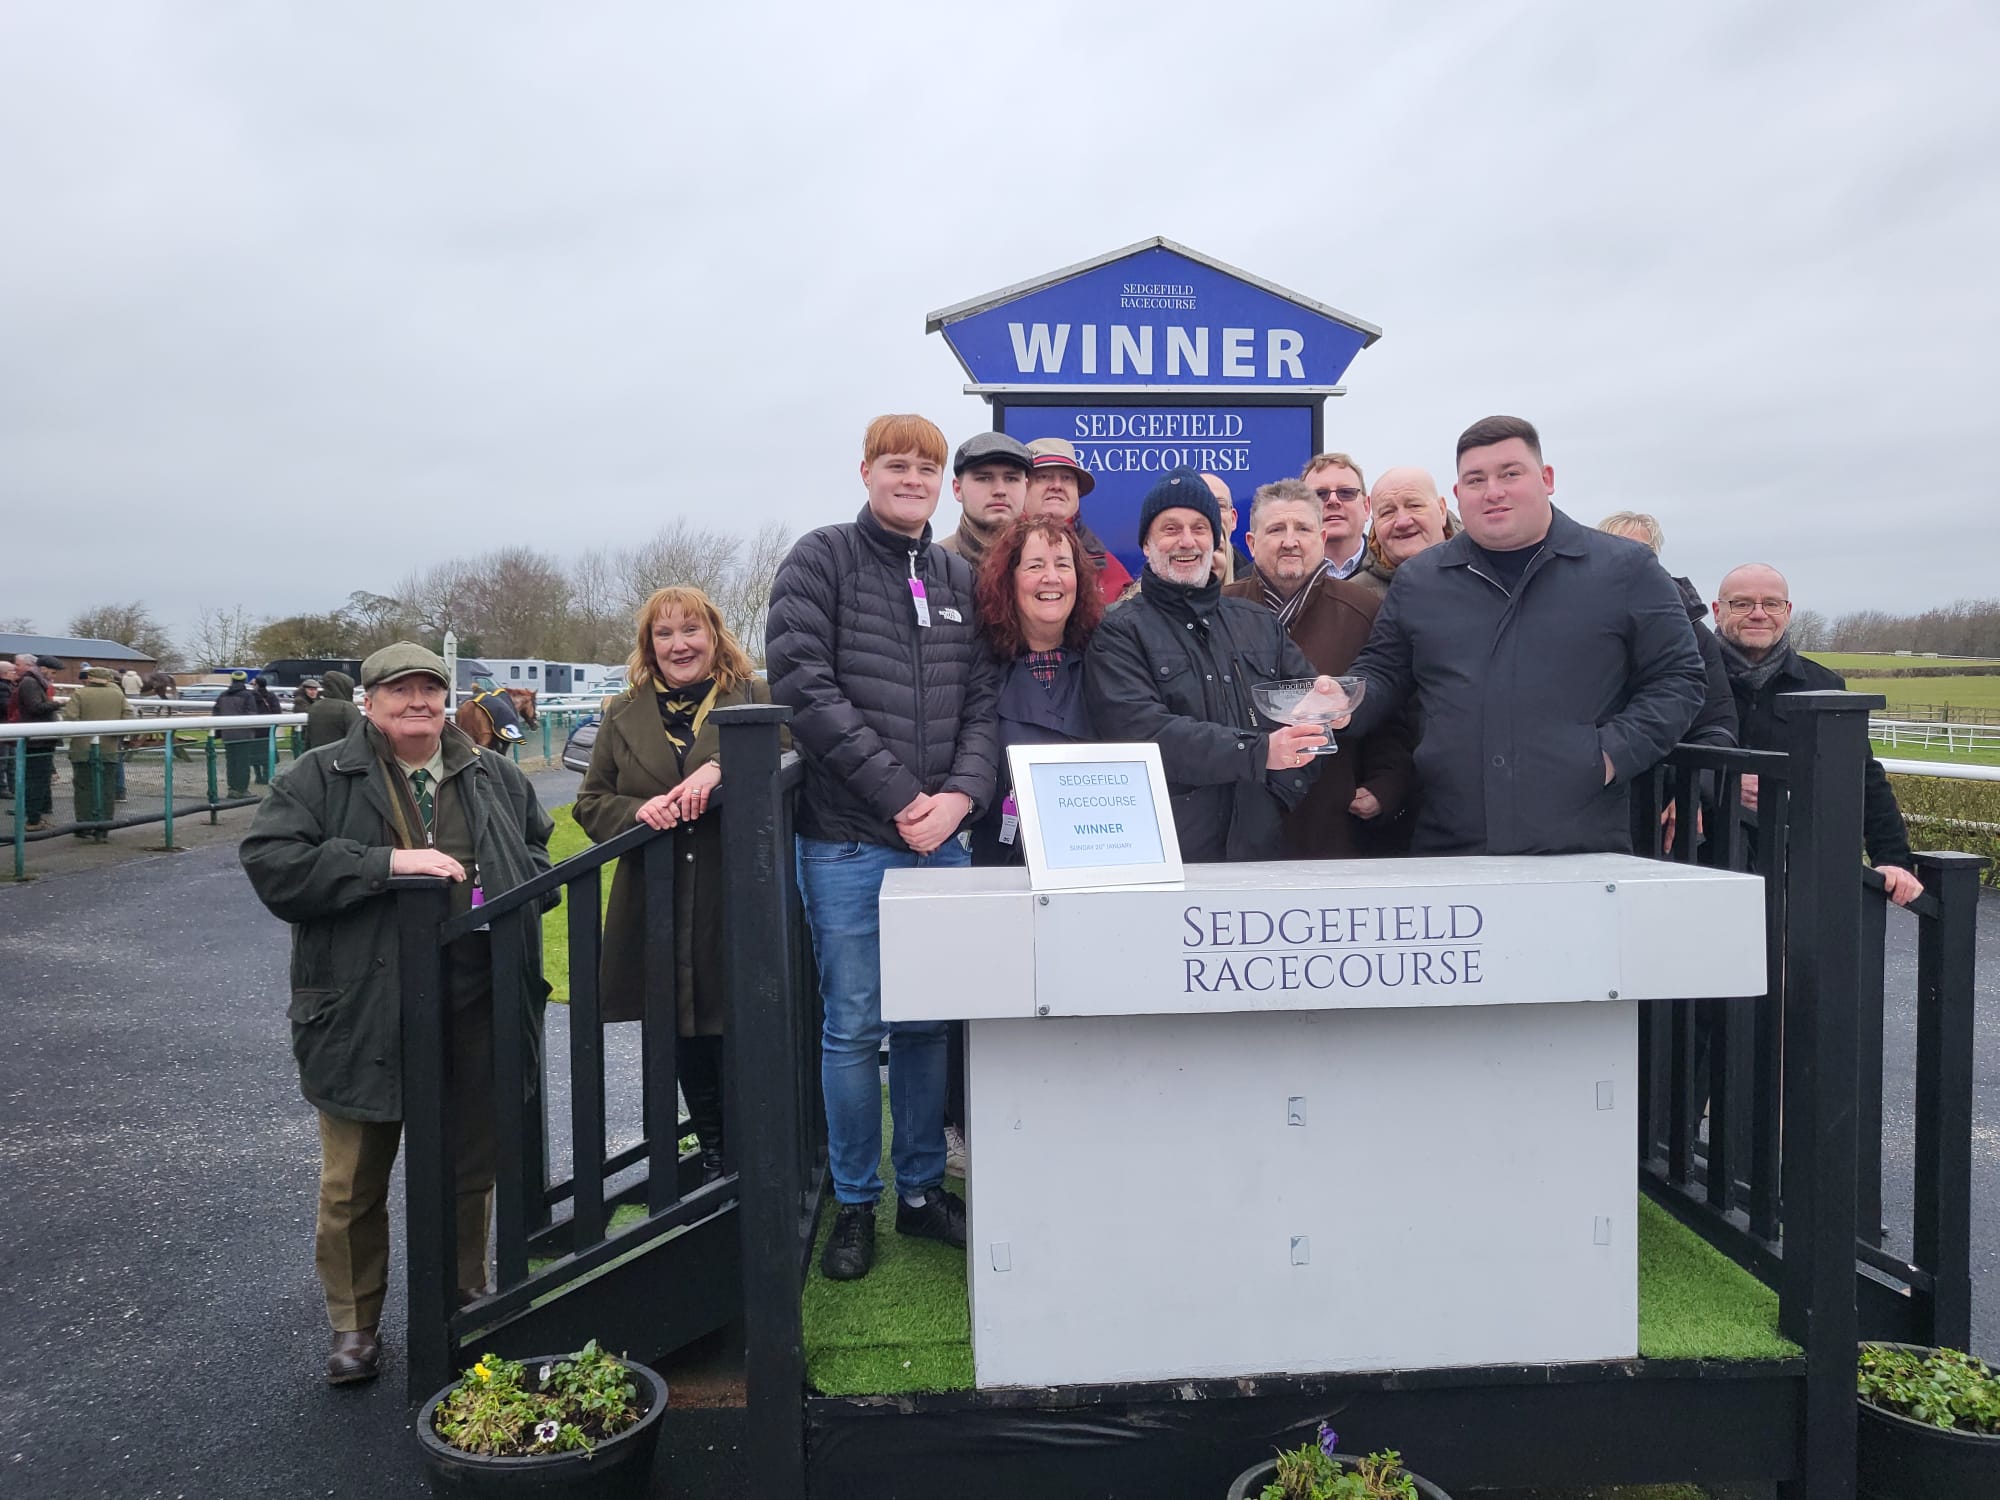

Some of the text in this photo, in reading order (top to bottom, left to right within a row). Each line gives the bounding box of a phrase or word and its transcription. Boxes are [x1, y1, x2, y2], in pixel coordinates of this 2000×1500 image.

[1123, 283, 1194, 295] SEDGEFIELD
[1121, 297, 1197, 310] RACECOURSE
[1008, 322, 1306, 379] WINNER
[1075, 414, 1243, 437] SEDGEFIELD
[1074, 448, 1250, 472] RACECOURSE
[1059, 774, 1129, 786] SEDGEFIELD
[1058, 795, 1137, 808] RACECOURSE
[1073, 823, 1124, 835] WINNER
[1183, 904, 1484, 947] SEDGEFIELD
[1183, 950, 1484, 993] RACECOURSE
